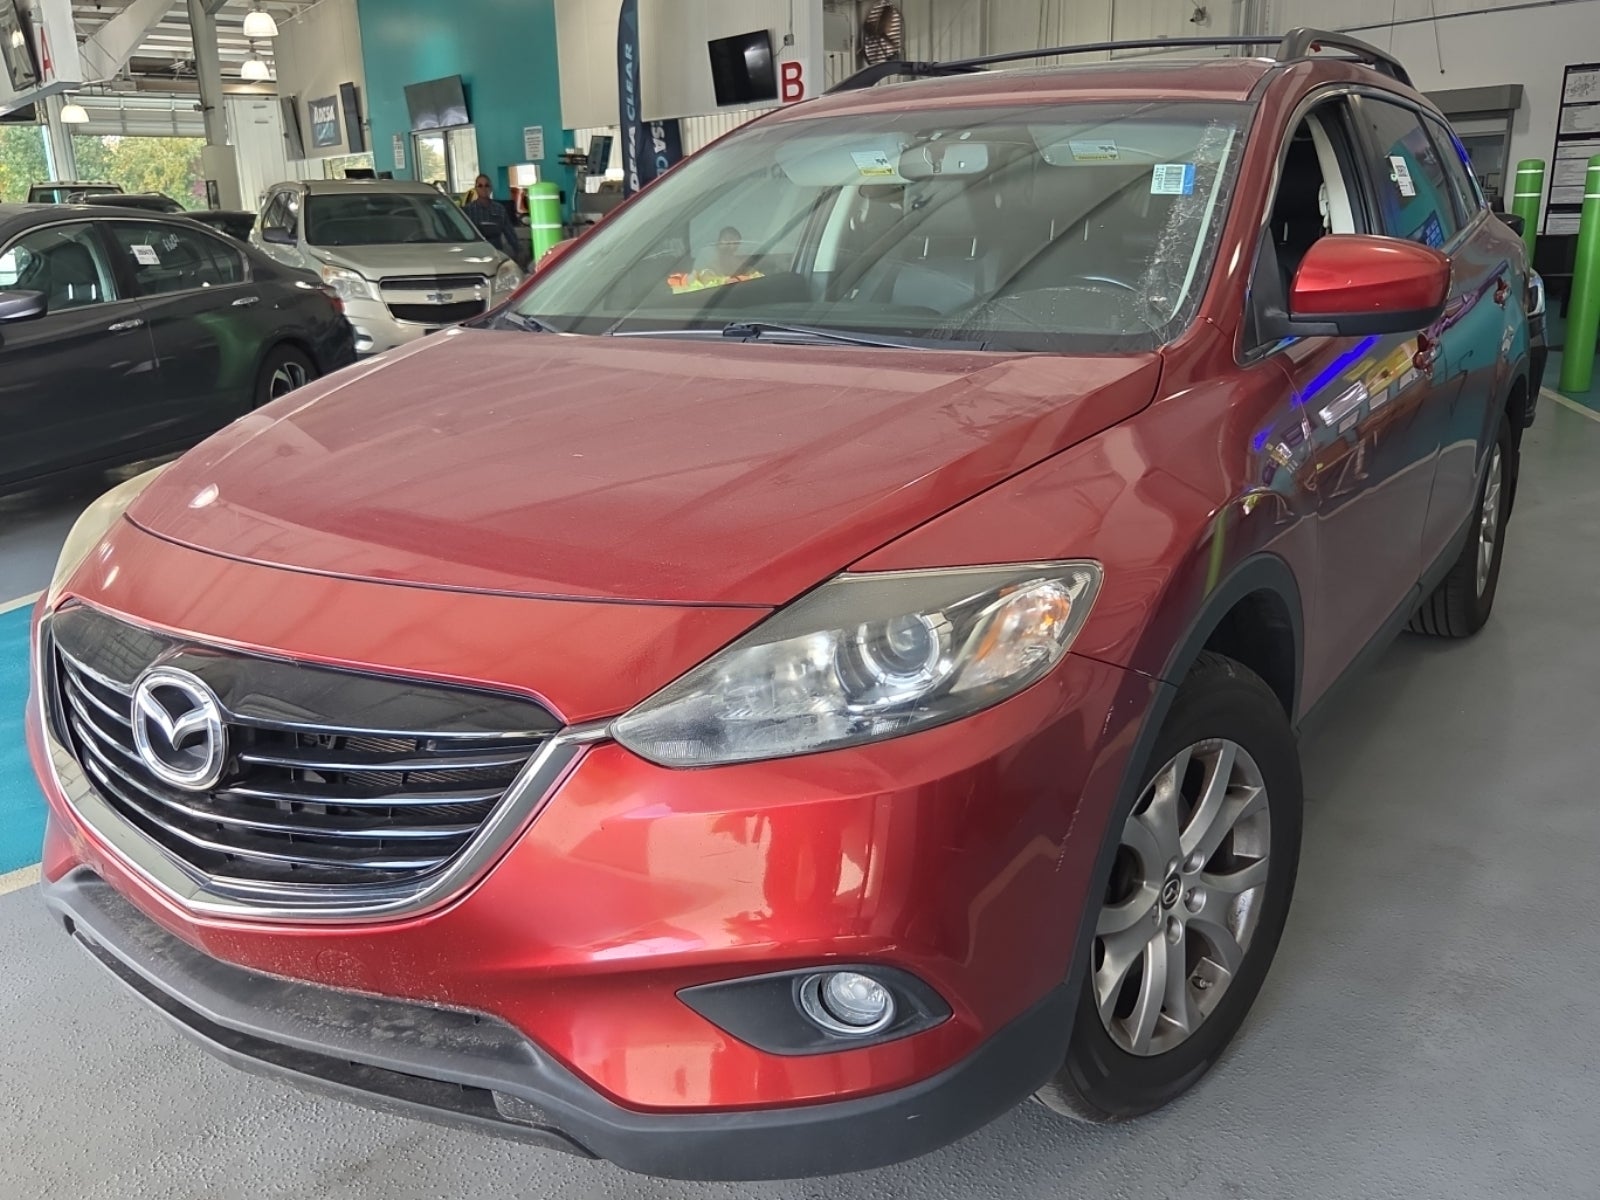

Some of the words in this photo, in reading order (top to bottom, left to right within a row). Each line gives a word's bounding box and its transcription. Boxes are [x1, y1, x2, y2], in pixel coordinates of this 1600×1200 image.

[40, 26, 55, 82] A
[625, 43, 635, 121] CLEAR
[781, 61, 804, 103] B
